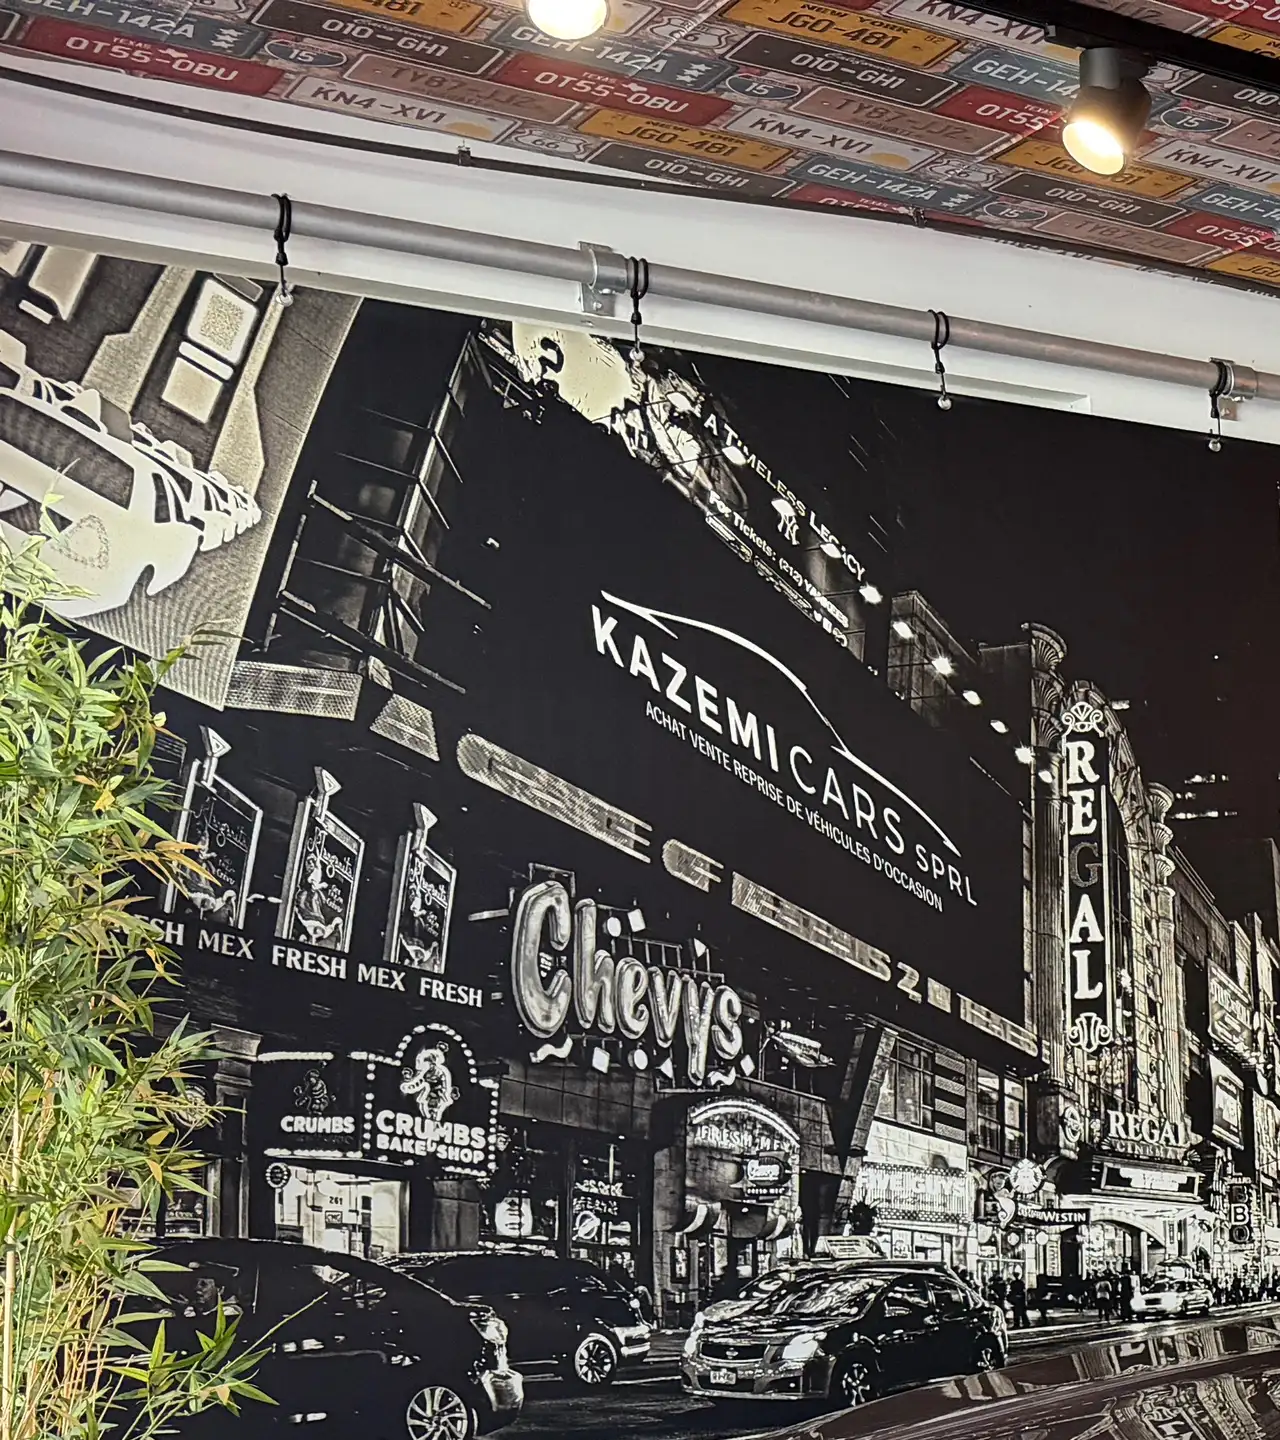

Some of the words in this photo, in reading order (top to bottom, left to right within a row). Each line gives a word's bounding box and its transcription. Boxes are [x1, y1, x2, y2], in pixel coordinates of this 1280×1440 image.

[768, 10, 903, 50] JGO-481
[800, 3, 848, 24] NEW
[744, 81, 769, 95] 15
[1177, 113, 1202, 129] 15
[806, 163, 938, 202] GEH-142A
[645, 700, 687, 741] ACHAT
[689, 729, 732, 772] VENTE
[733, 758, 785, 808] REPRISE
[786, 793, 805, 822] DE
[805, 804, 872, 866] VÉHICULES
[873, 852, 943, 913] D'OCCASION
[914, 843, 979, 907] SPRL
[1065, 738, 1104, 1001] REGAL
[198, 929, 255, 961] MEX
[271, 944, 347, 980] FRESH
[357, 963, 406, 992] MEX
[419, 976, 484, 1010] FRESH
[512, 880, 744, 1086] Chevys
[280, 1114, 356, 1134] CRUMBS
[375, 1109, 486, 1150] CRUMBS
[1107, 1108, 1190, 1148] REGAL
[375, 1133, 428, 1157] BAKE
[435, 1144, 485, 1165] SHOP
[328, 1195, 344, 1206] 261
[1043, 1209, 1087, 1223] WESTIN
